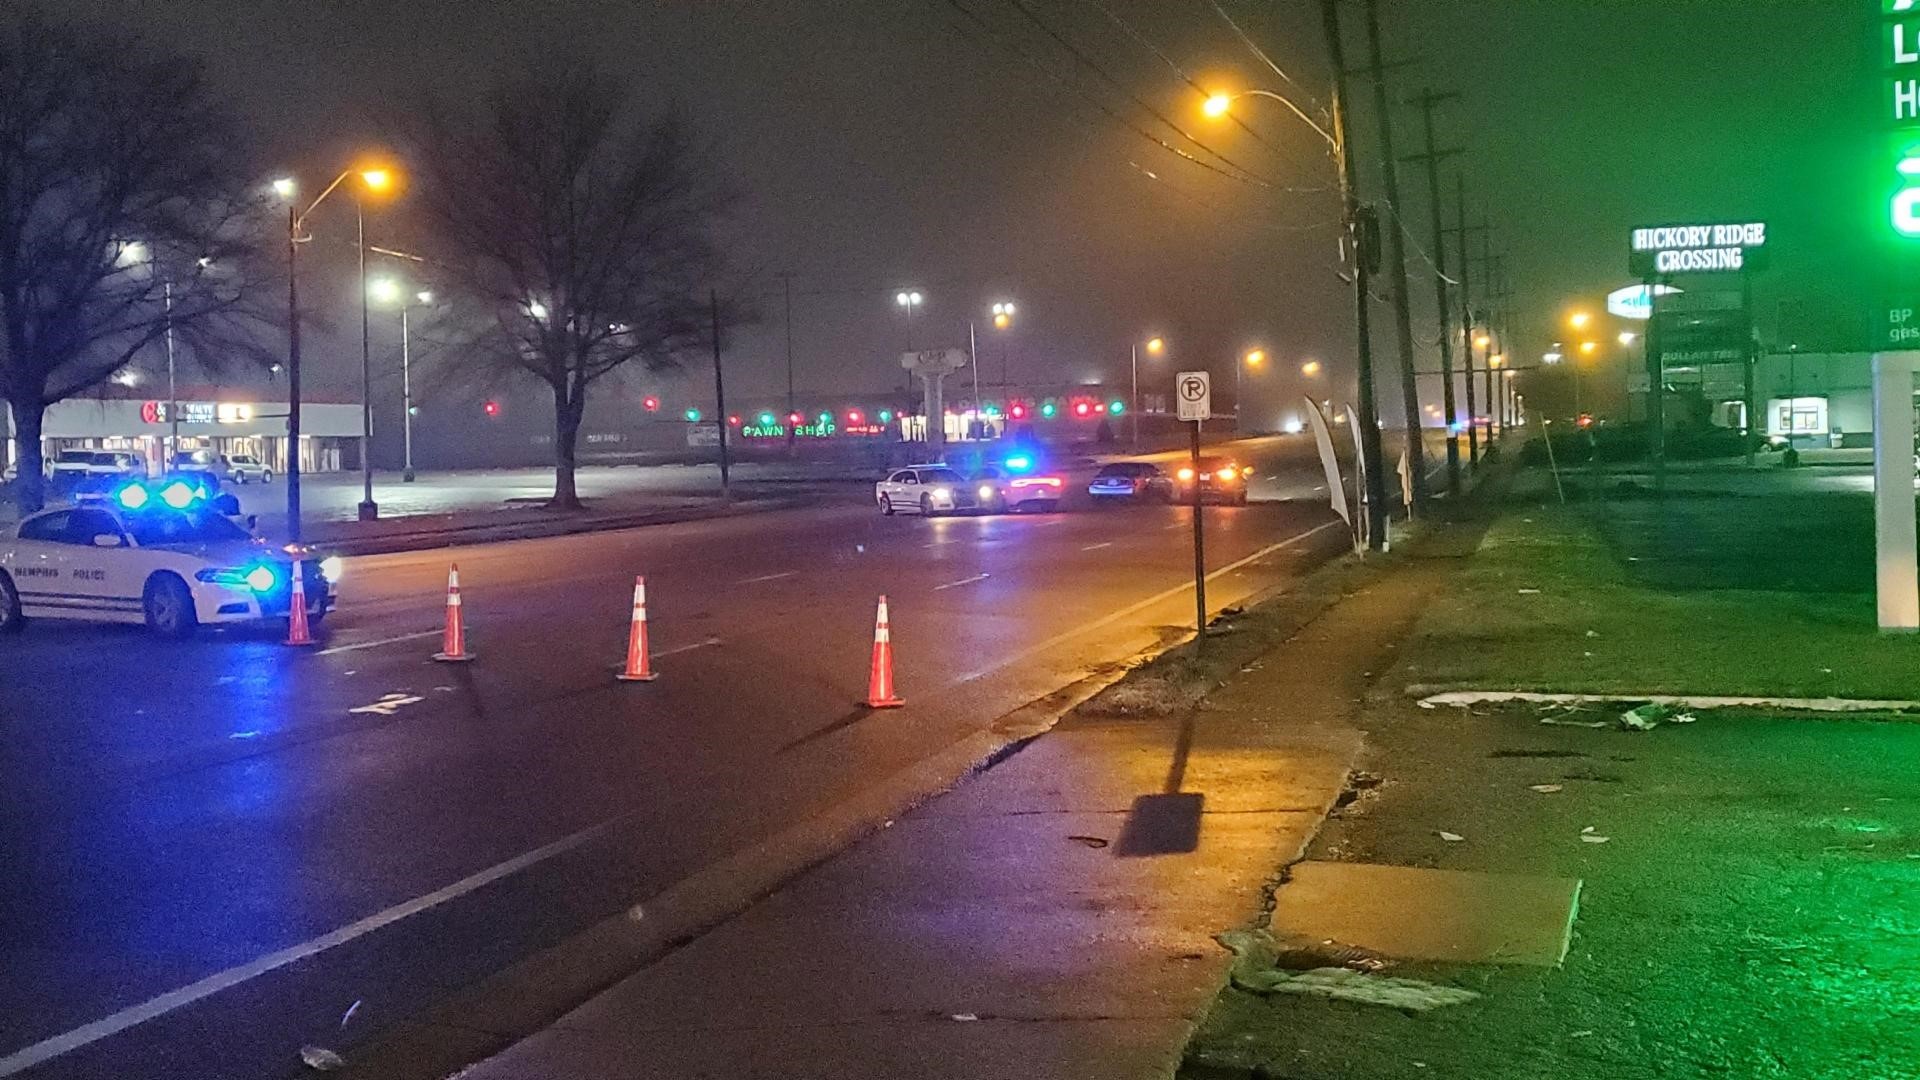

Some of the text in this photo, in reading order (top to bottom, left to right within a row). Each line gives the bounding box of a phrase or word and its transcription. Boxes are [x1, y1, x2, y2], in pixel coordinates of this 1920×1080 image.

[1633, 222, 1766, 250] HICKORY RIDGE
[1656, 247, 1743, 272] CROSSING
[1889, 308, 1913, 323] BP
[742, 425, 783, 437] PAWN
[795, 424, 836, 437] SHOP
[14, 568, 105, 580] MEMPHIS POLICE
